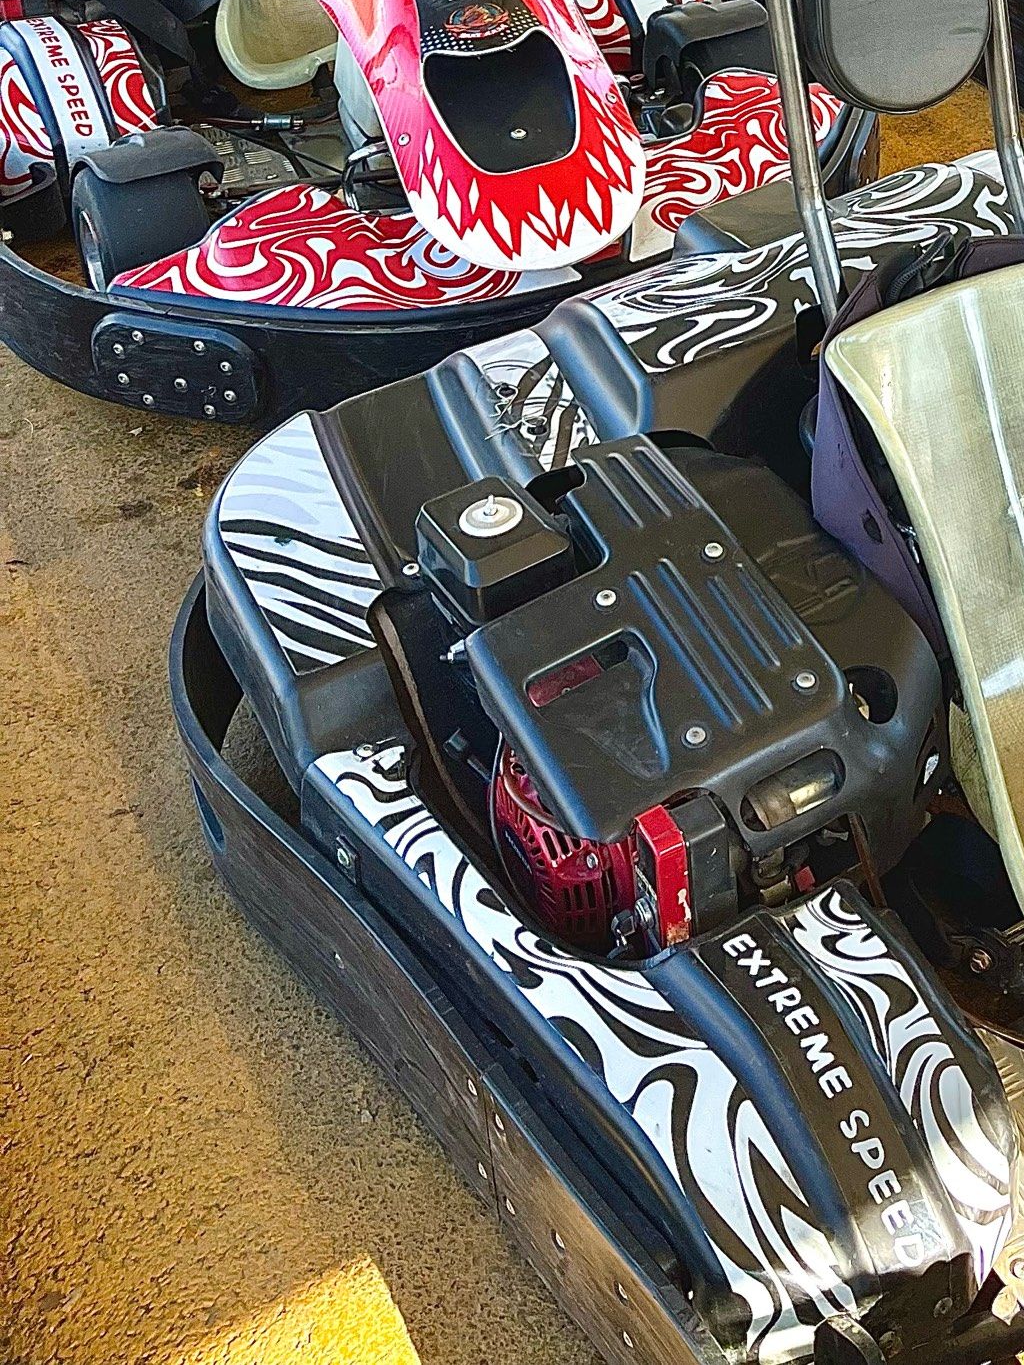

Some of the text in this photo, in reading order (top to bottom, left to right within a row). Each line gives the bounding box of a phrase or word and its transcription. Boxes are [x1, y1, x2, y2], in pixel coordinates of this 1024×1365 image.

[26, 18, 93, 137] EXTREME SPEED
[721, 932, 928, 1267] EXTREME SPEED
